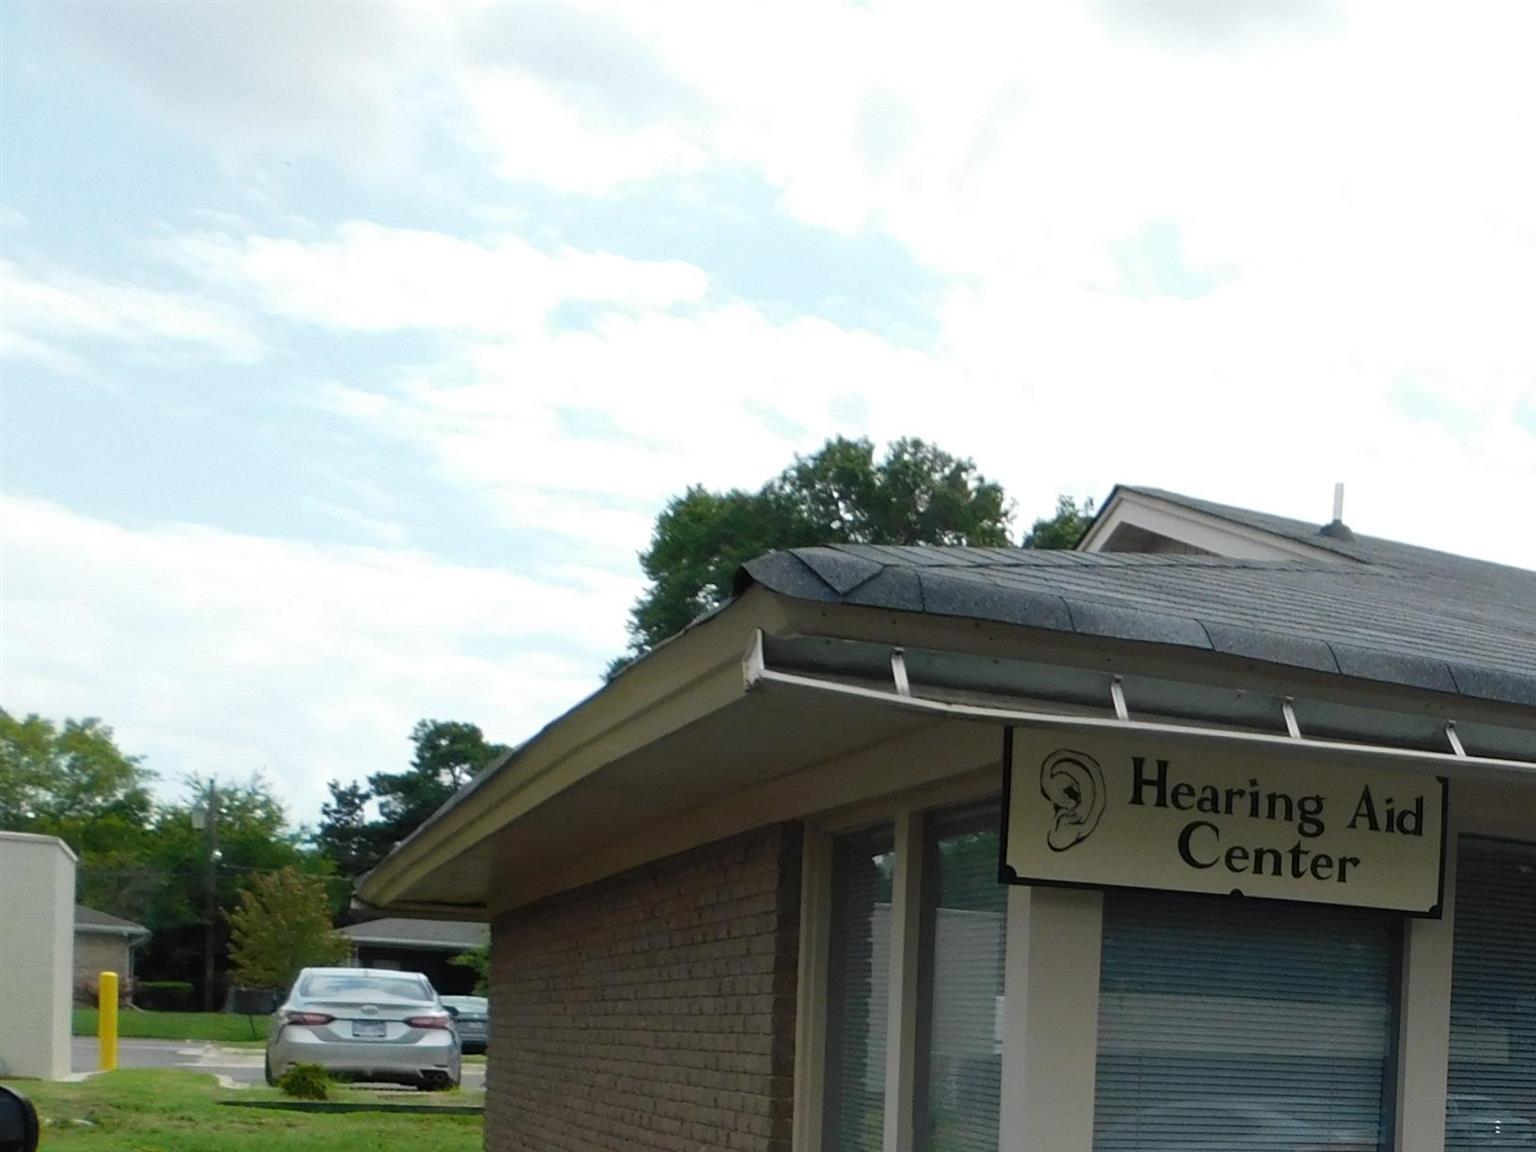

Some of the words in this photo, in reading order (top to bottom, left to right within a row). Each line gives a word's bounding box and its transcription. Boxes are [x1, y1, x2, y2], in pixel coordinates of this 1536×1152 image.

[1128, 756, 1326, 838] Hearing
[1346, 783, 1424, 836] Aid
[1177, 820, 1361, 883] Center
